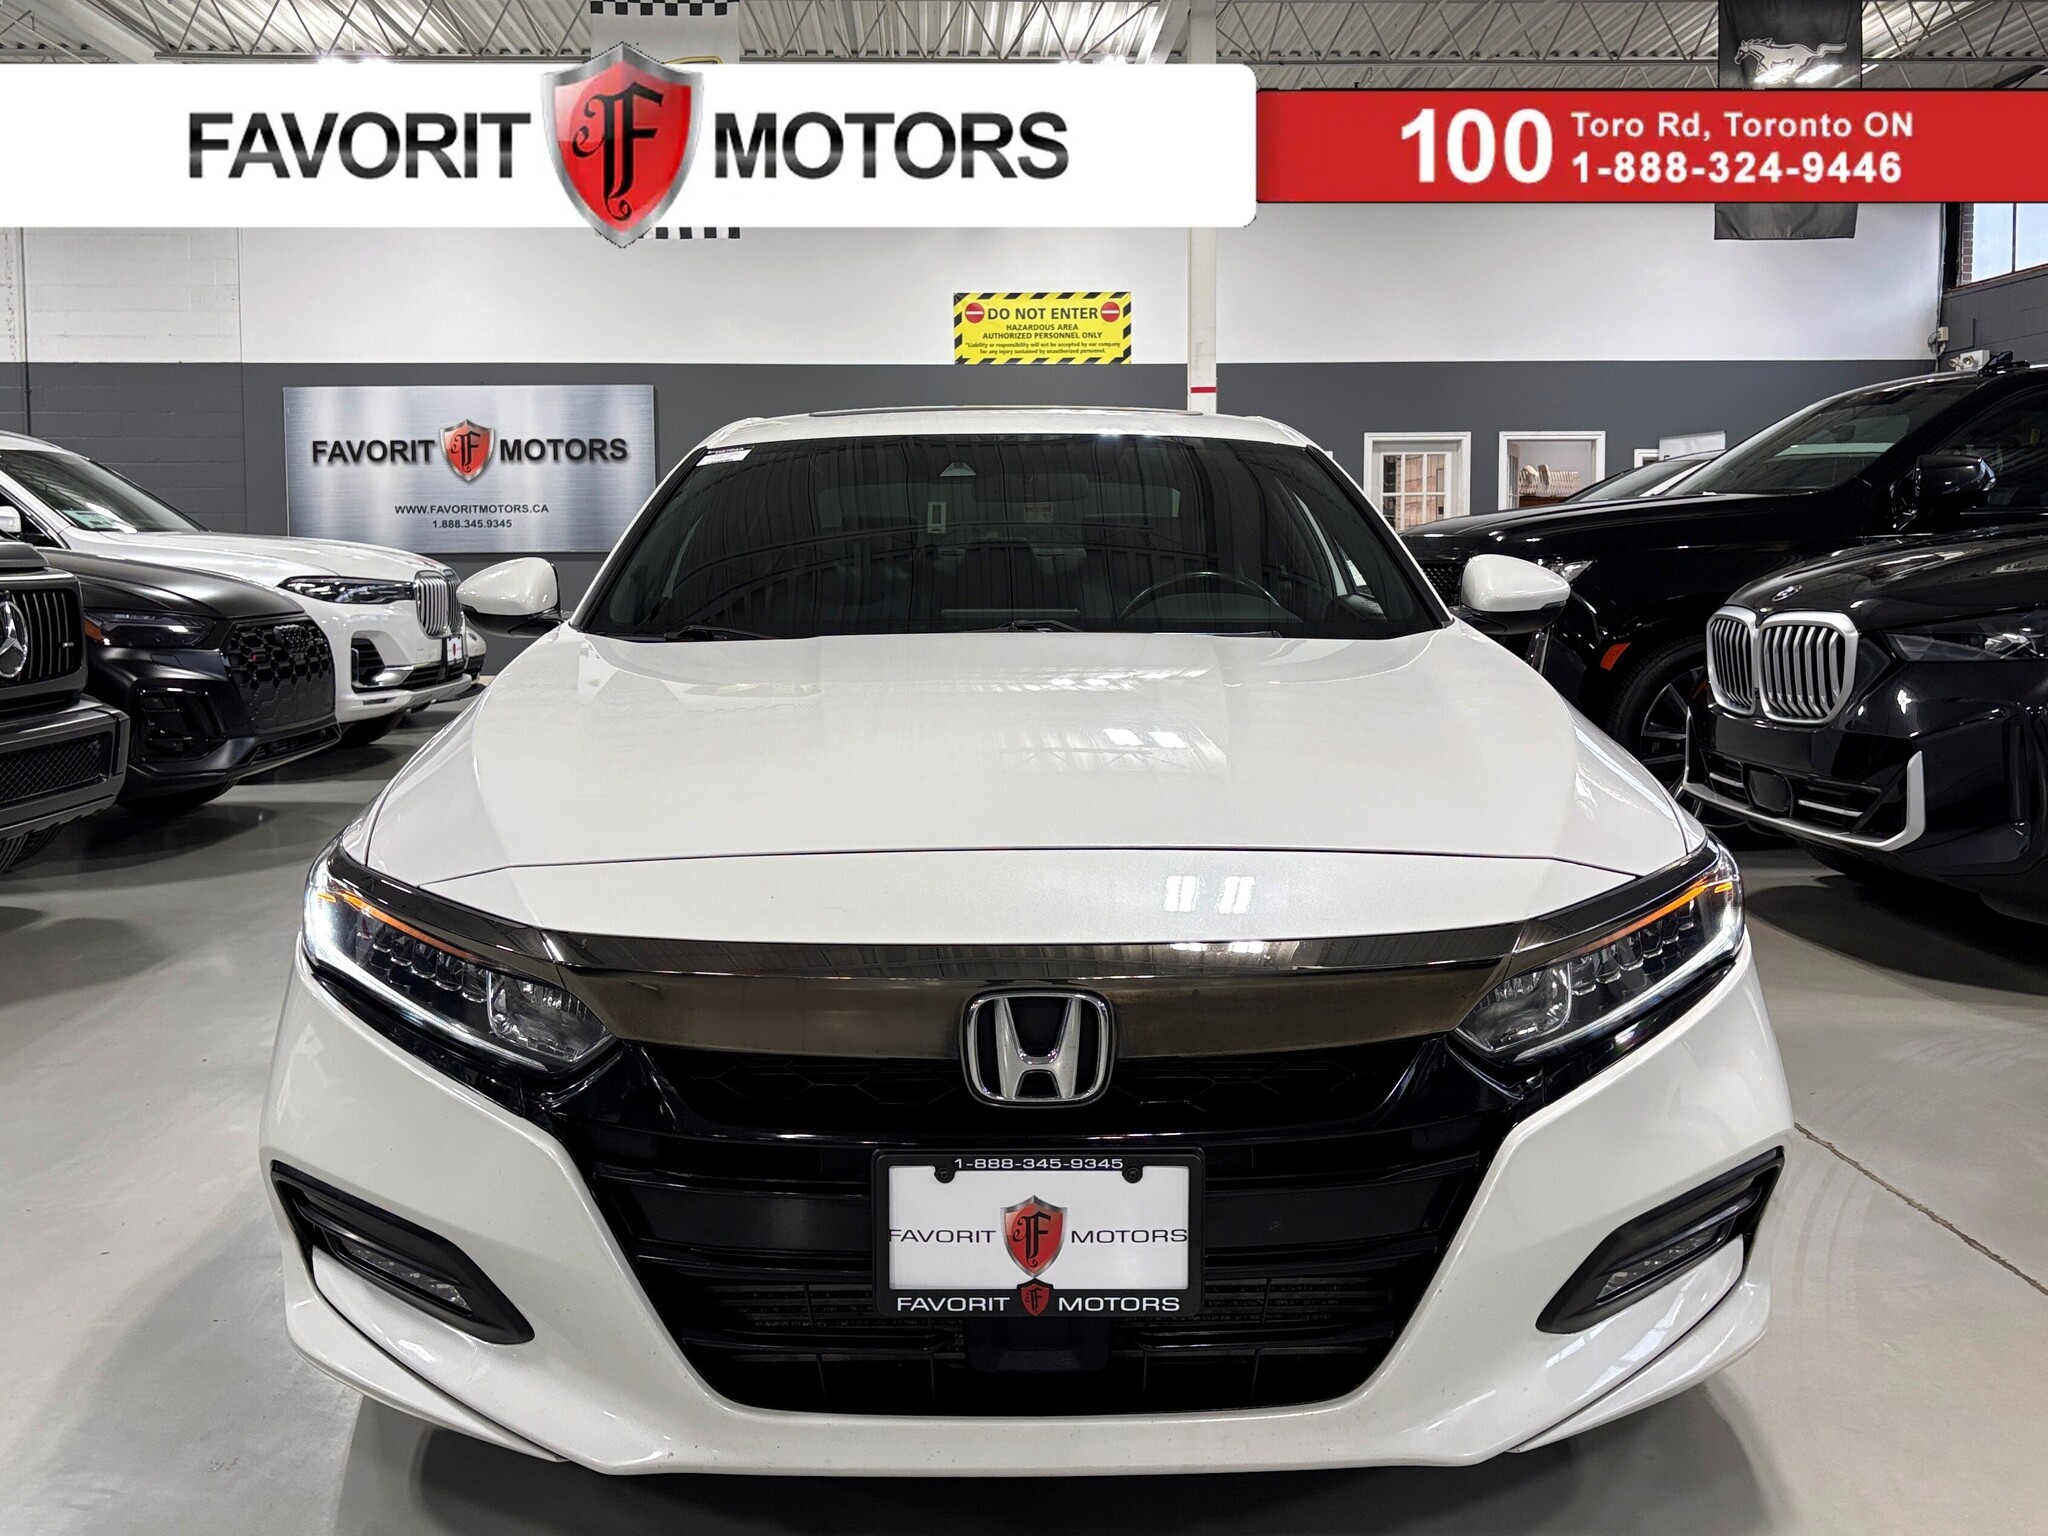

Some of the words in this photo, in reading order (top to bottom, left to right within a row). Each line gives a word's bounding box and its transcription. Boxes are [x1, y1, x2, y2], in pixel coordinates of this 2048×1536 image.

[988, 308, 1010, 320] DO
[1015, 308, 1046, 320] NOT
[1051, 307, 1098, 319] ENTER
[1057, 323, 1079, 331] AREA
[1081, 331, 1103, 339] ONLY
[312, 440, 435, 463] FAVORIT
[500, 439, 628, 462] MOTORS
[394, 504, 549, 514] WWW.FAVORITMOTORS.CA
[432, 519, 512, 529] 1.888.345.9345
[954, 1158, 1124, 1170] 1-888-345-9345
[889, 1229, 996, 1244] FAVORIT
[1071, 1228, 1188, 1244] MOTORS
[897, 1297, 1010, 1312] FAVORIT
[1058, 1297, 1180, 1312] MOTORS
